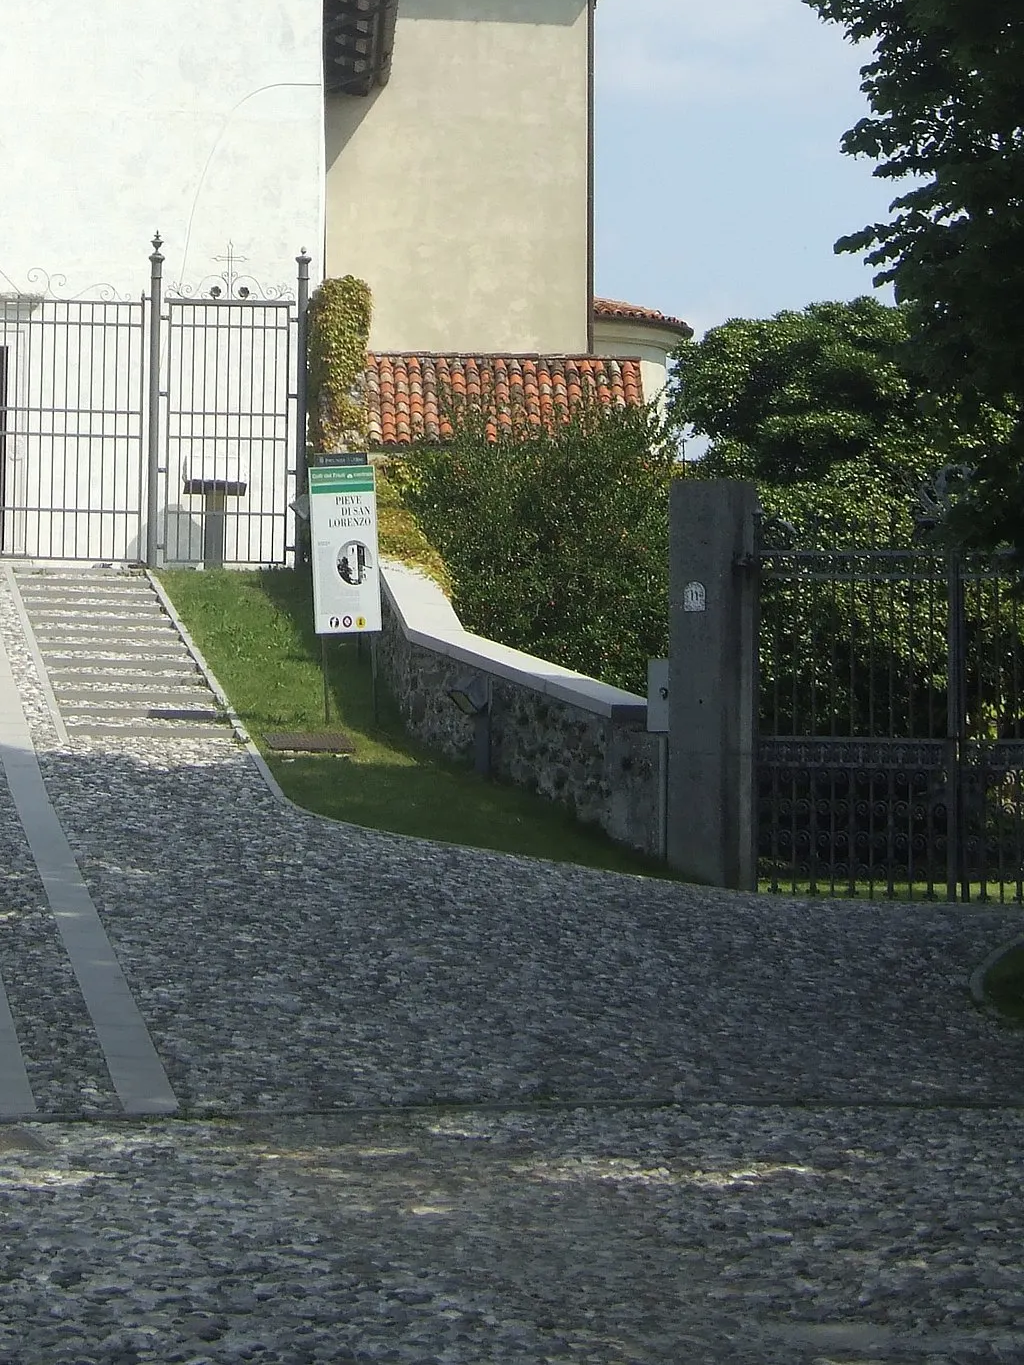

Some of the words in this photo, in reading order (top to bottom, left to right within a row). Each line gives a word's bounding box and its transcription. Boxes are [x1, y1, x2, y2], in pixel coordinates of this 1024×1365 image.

[335, 496, 362, 505] PIEVE
[341, 507, 351, 516] DI
[353, 506, 370, 515] SAN
[329, 518, 371, 527] LORENZO
